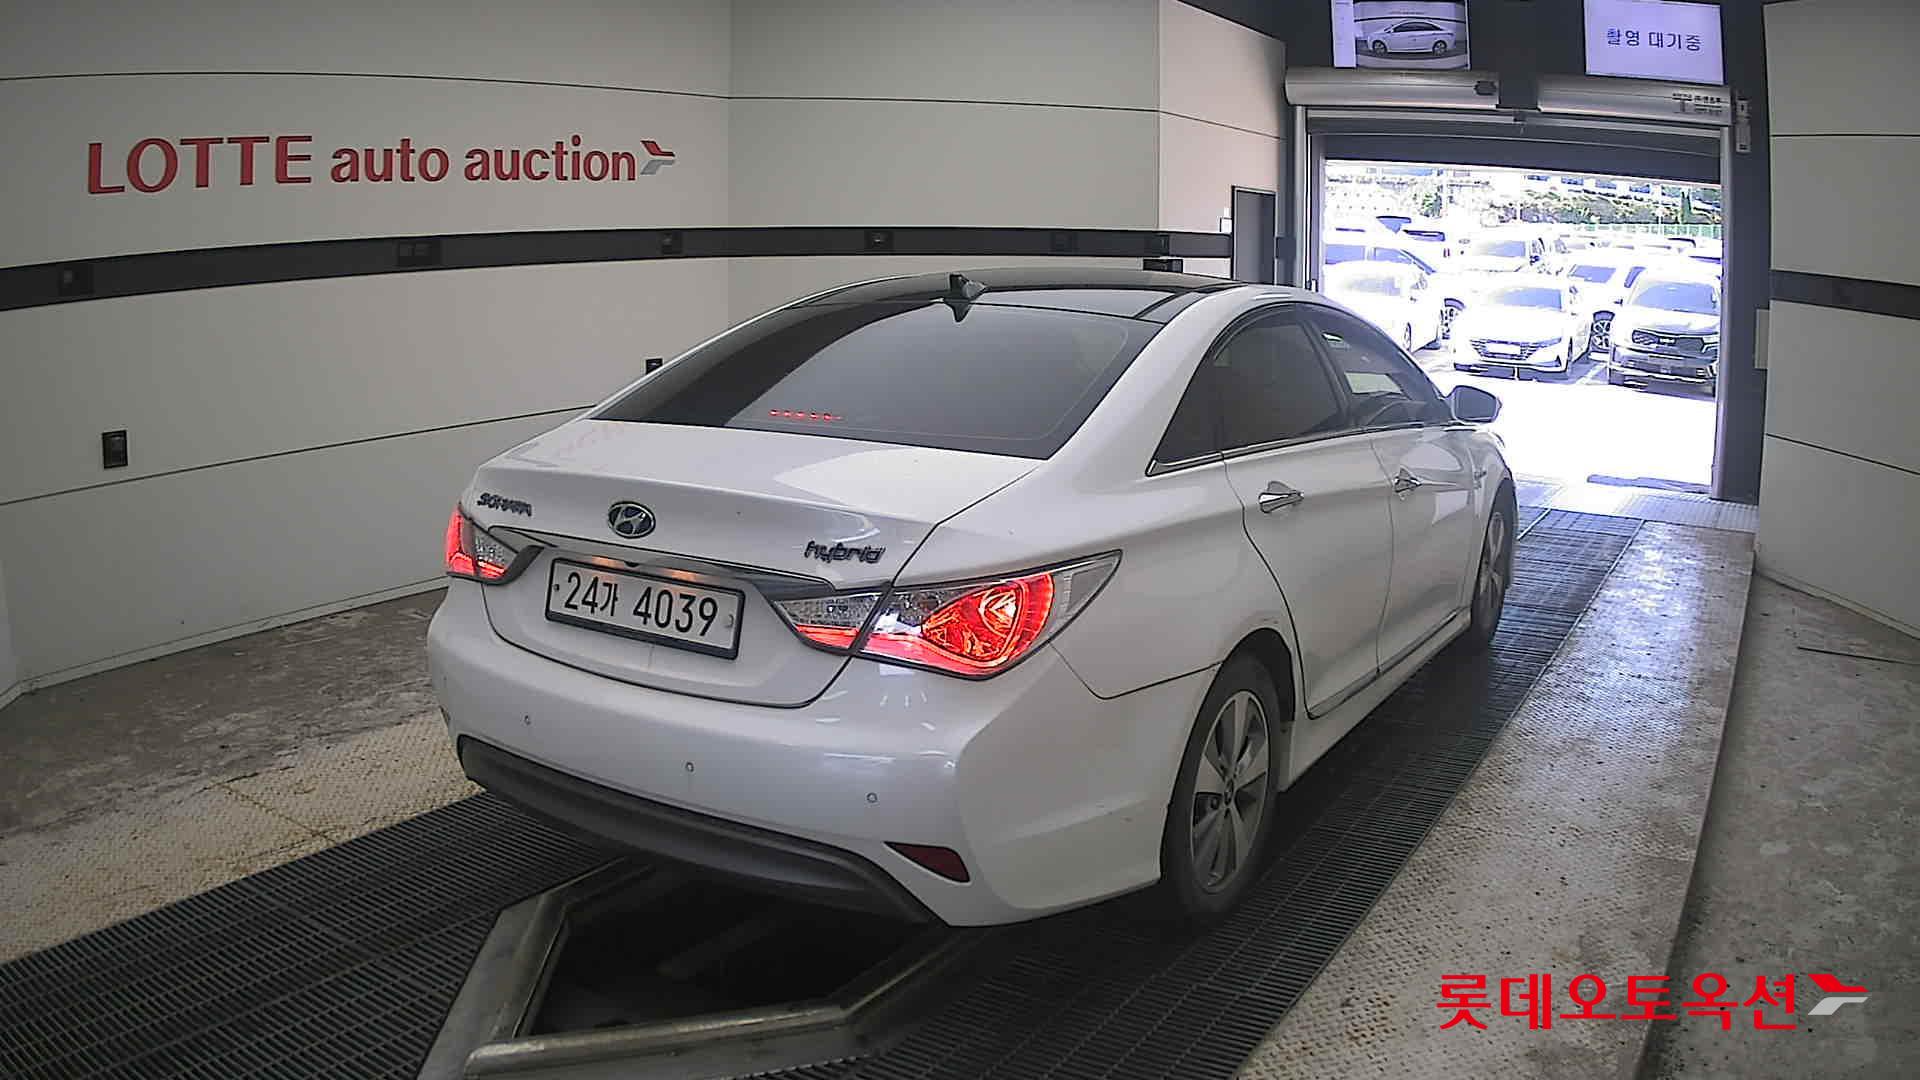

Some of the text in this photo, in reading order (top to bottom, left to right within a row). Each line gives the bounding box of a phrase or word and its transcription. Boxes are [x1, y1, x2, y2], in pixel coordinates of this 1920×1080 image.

[1607, 28, 1702, 52] 촬영 대기중
[87, 134, 638, 195] LOTTE auto auction
[804, 540, 886, 564] hybrid
[564, 571, 719, 637] 24가 4039
